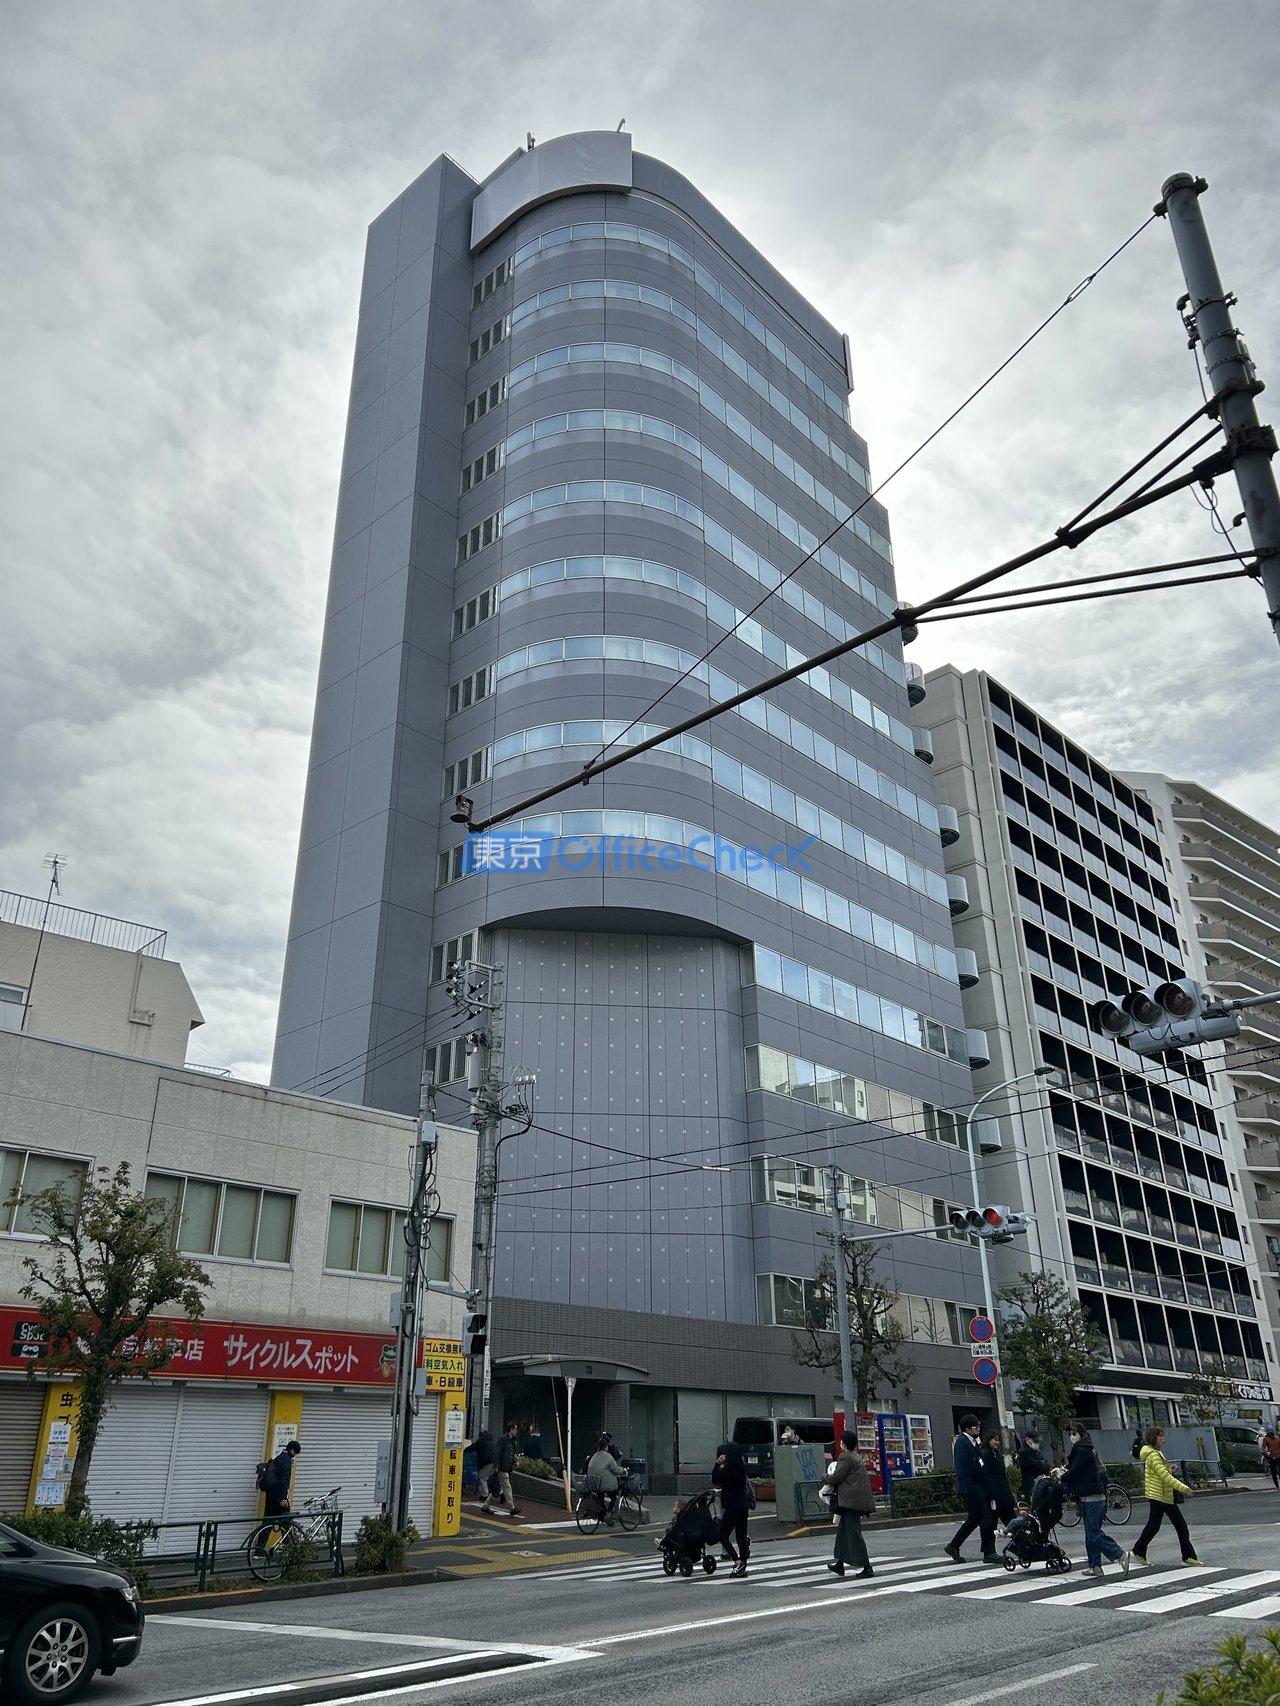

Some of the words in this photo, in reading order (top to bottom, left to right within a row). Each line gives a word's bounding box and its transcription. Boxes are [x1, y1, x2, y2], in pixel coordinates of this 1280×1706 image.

[223, 1334, 359, 1374] サイクルスポット
[423, 1358, 463, 1371] 料空気入れ
